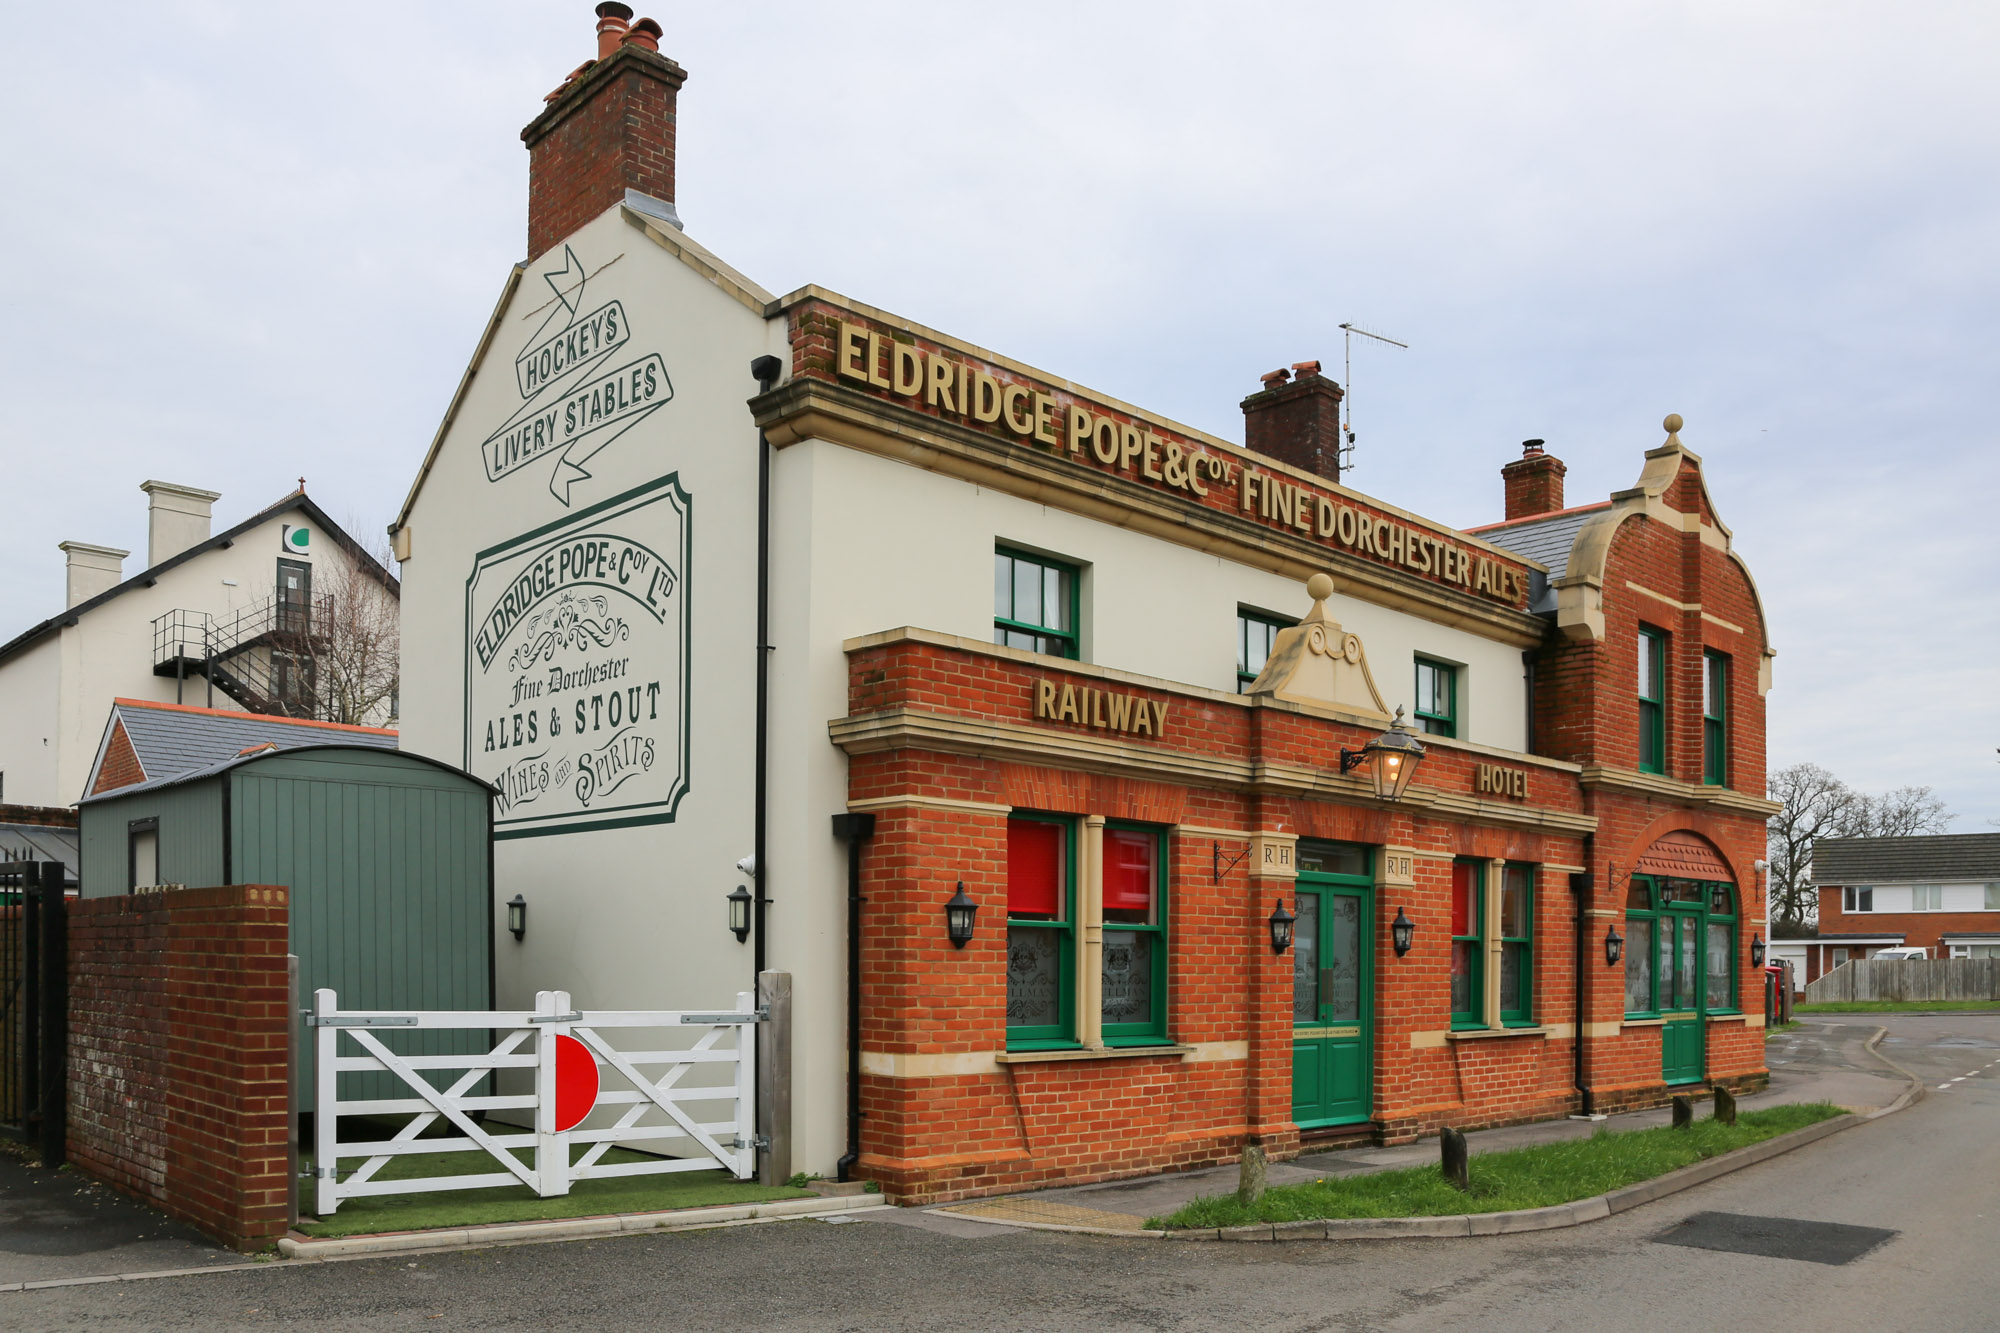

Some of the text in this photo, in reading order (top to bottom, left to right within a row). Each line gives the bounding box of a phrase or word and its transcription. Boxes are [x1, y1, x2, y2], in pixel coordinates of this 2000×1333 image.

[526, 307, 617, 391] HOCKEY'S
[493, 362, 657, 474] LIVERY STABLES
[837, 321, 1057, 446] ELDRIDGE
[1240, 469, 1311, 532] FINE
[1315, 496, 1471, 587] DORCHESTER
[1474, 556, 1522, 604] ALES
[475, 555, 556, 668] ELDRIDGE
[559, 541, 609, 583] POPE
[484, 681, 660, 752] ALES & STOUT
[508, 656, 629, 708] Fine Dorchester
[1036, 679, 1169, 737] RAILWAY
[492, 736, 655, 817] WINES AND SPIRITS
[1477, 763, 1531, 798] HOTEL
